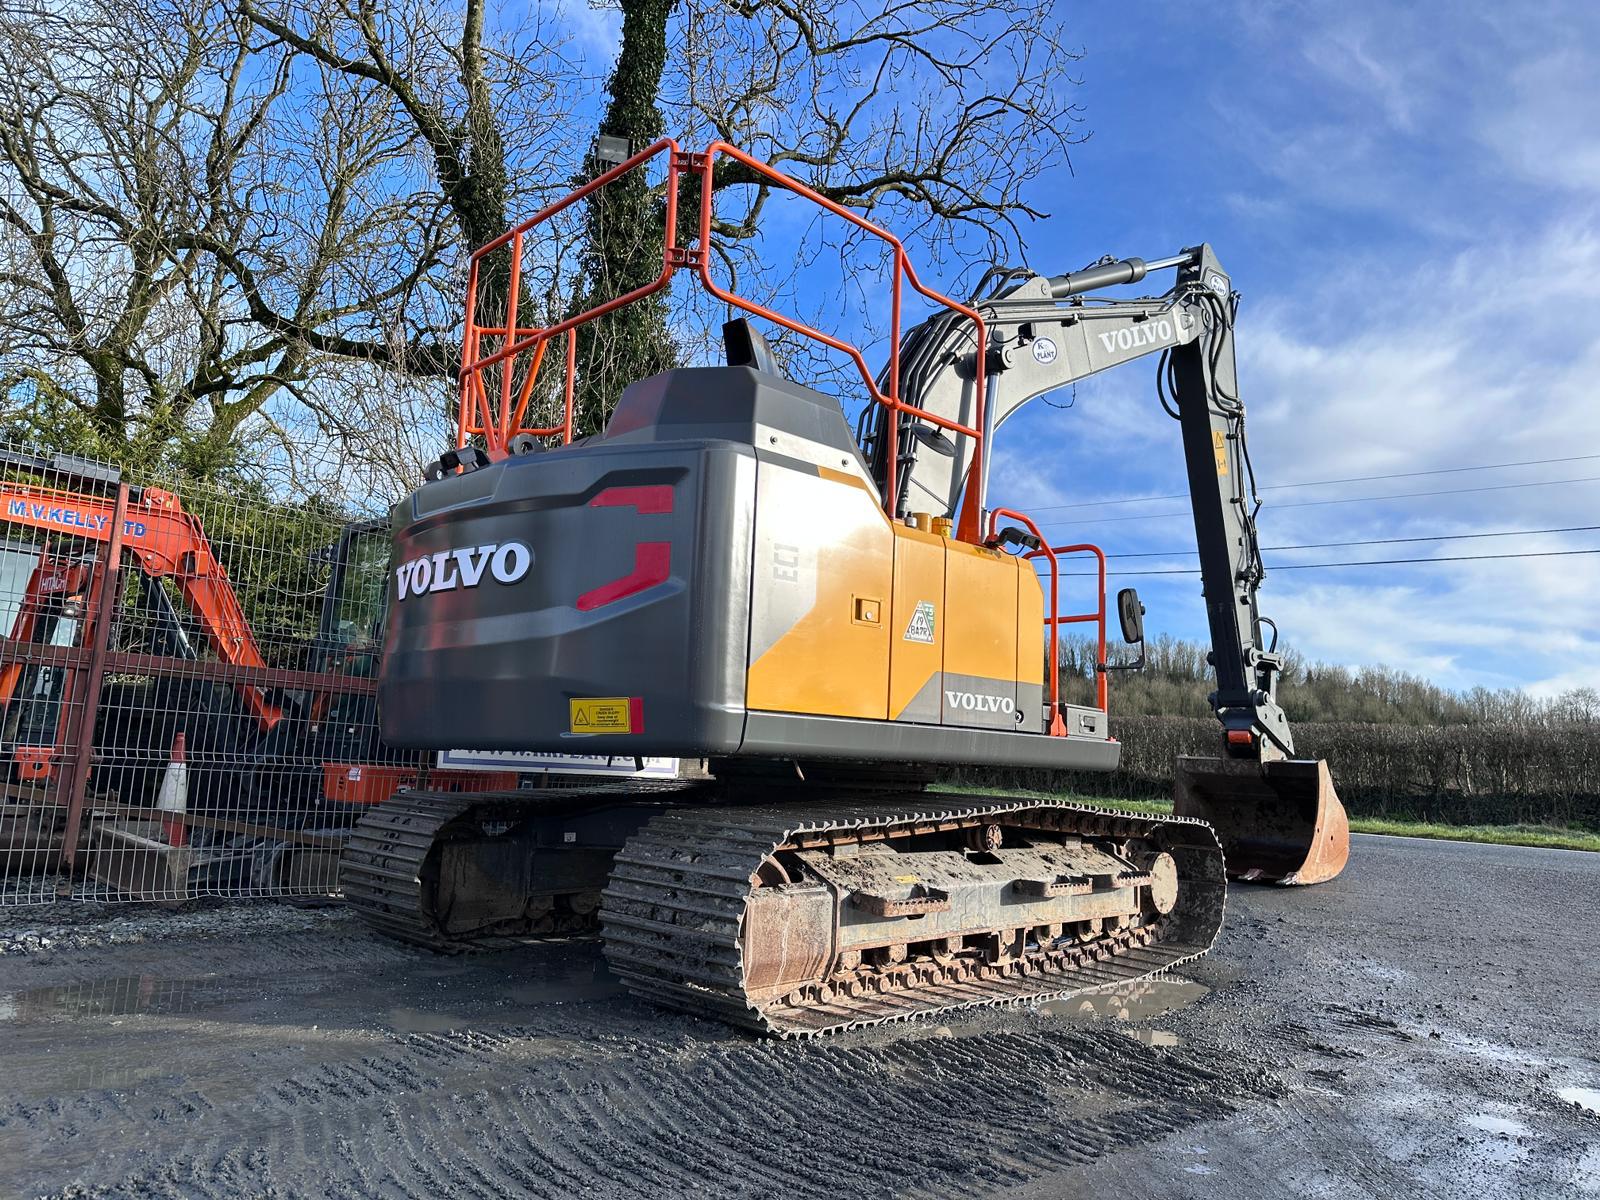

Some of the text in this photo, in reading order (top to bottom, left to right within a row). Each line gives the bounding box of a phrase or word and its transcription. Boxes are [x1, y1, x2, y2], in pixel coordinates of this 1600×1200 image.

[1098, 320, 1172, 353] VOLVO
[1037, 350, 1055, 359] PLANT
[8, 499, 146, 538] M.V.KELLY TD
[396, 542, 530, 601] VOLVO
[945, 691, 1014, 714] VOLVO
